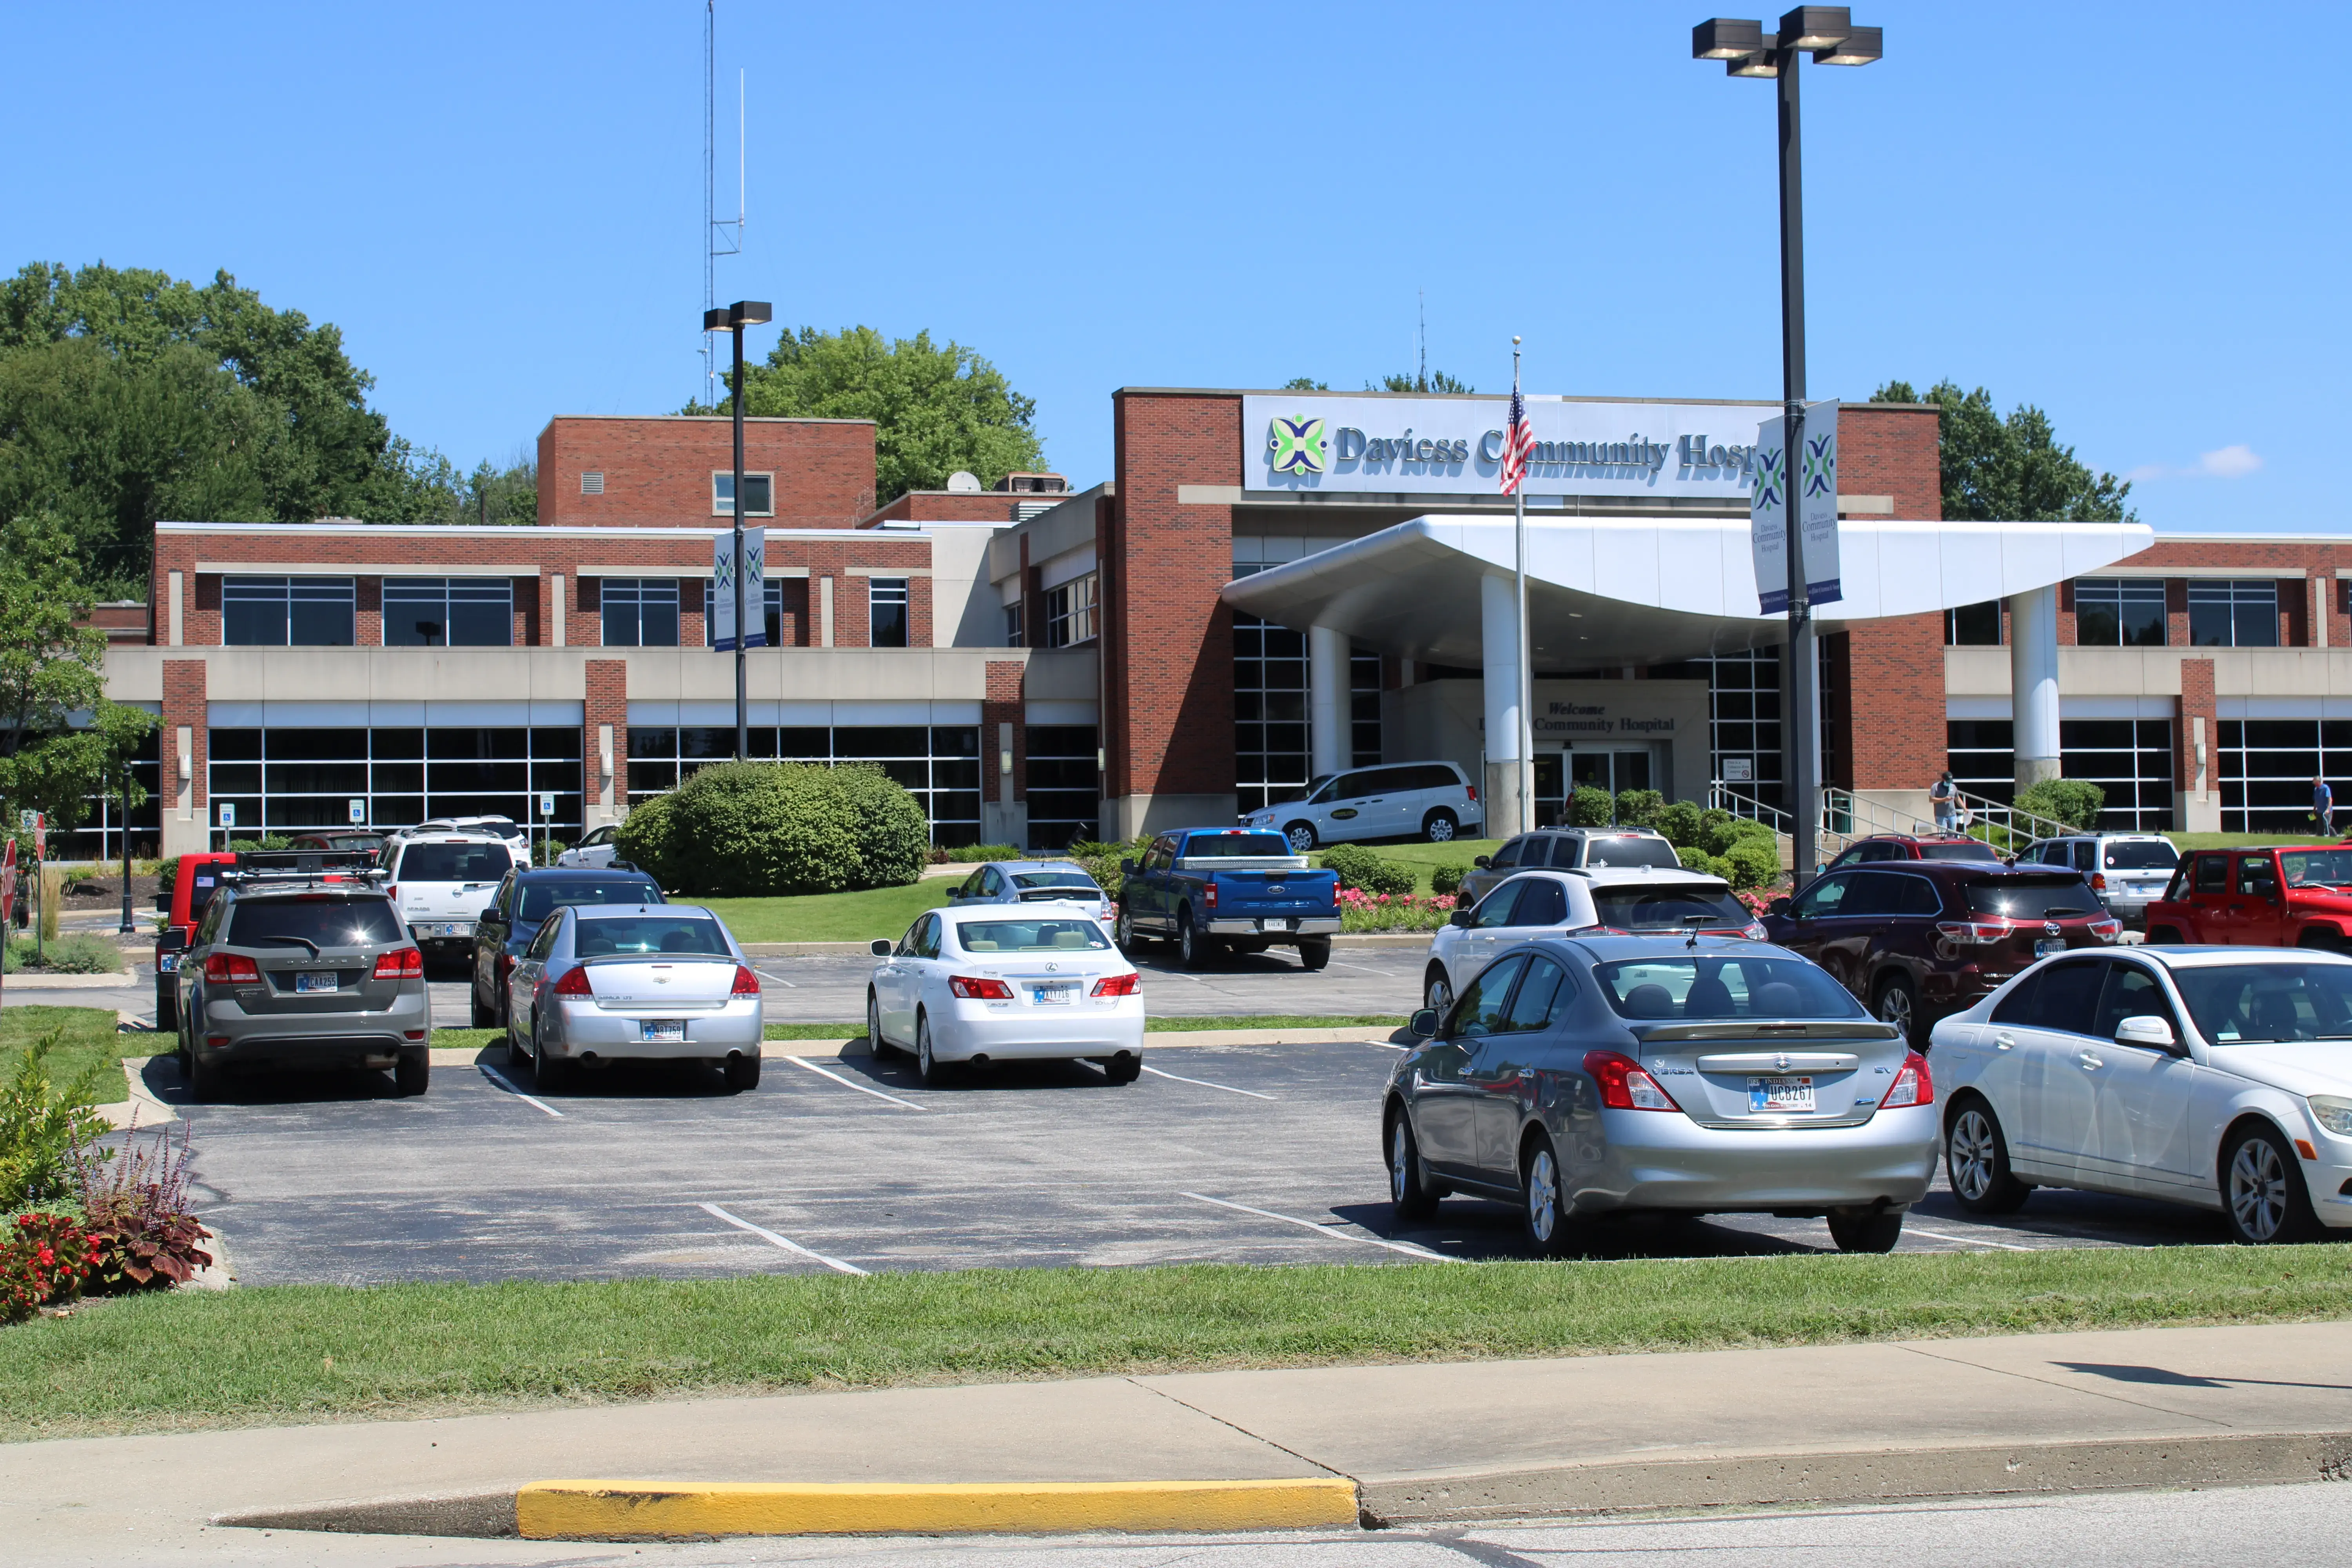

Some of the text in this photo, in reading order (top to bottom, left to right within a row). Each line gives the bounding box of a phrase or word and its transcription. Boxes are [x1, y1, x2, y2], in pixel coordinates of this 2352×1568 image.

[1337, 427, 1757, 474] Daviess Cmmunity Hosp
[1802, 516, 1837, 532] Community
[1753, 528, 1786, 544] Community
[1810, 530, 1829, 542] Hospital
[1761, 542, 1779, 553] Hospital
[1548, 702, 1606, 715] Welcome
[1533, 717, 1675, 733] Community Hospital
[310, 977, 336, 987] CAA255
[1045, 989, 1069, 998] XYY716
[656, 1025, 681, 1035] WBT759
[1874, 1066, 1892, 1074] SV
[1770, 1085, 1811, 1101] UCB267
